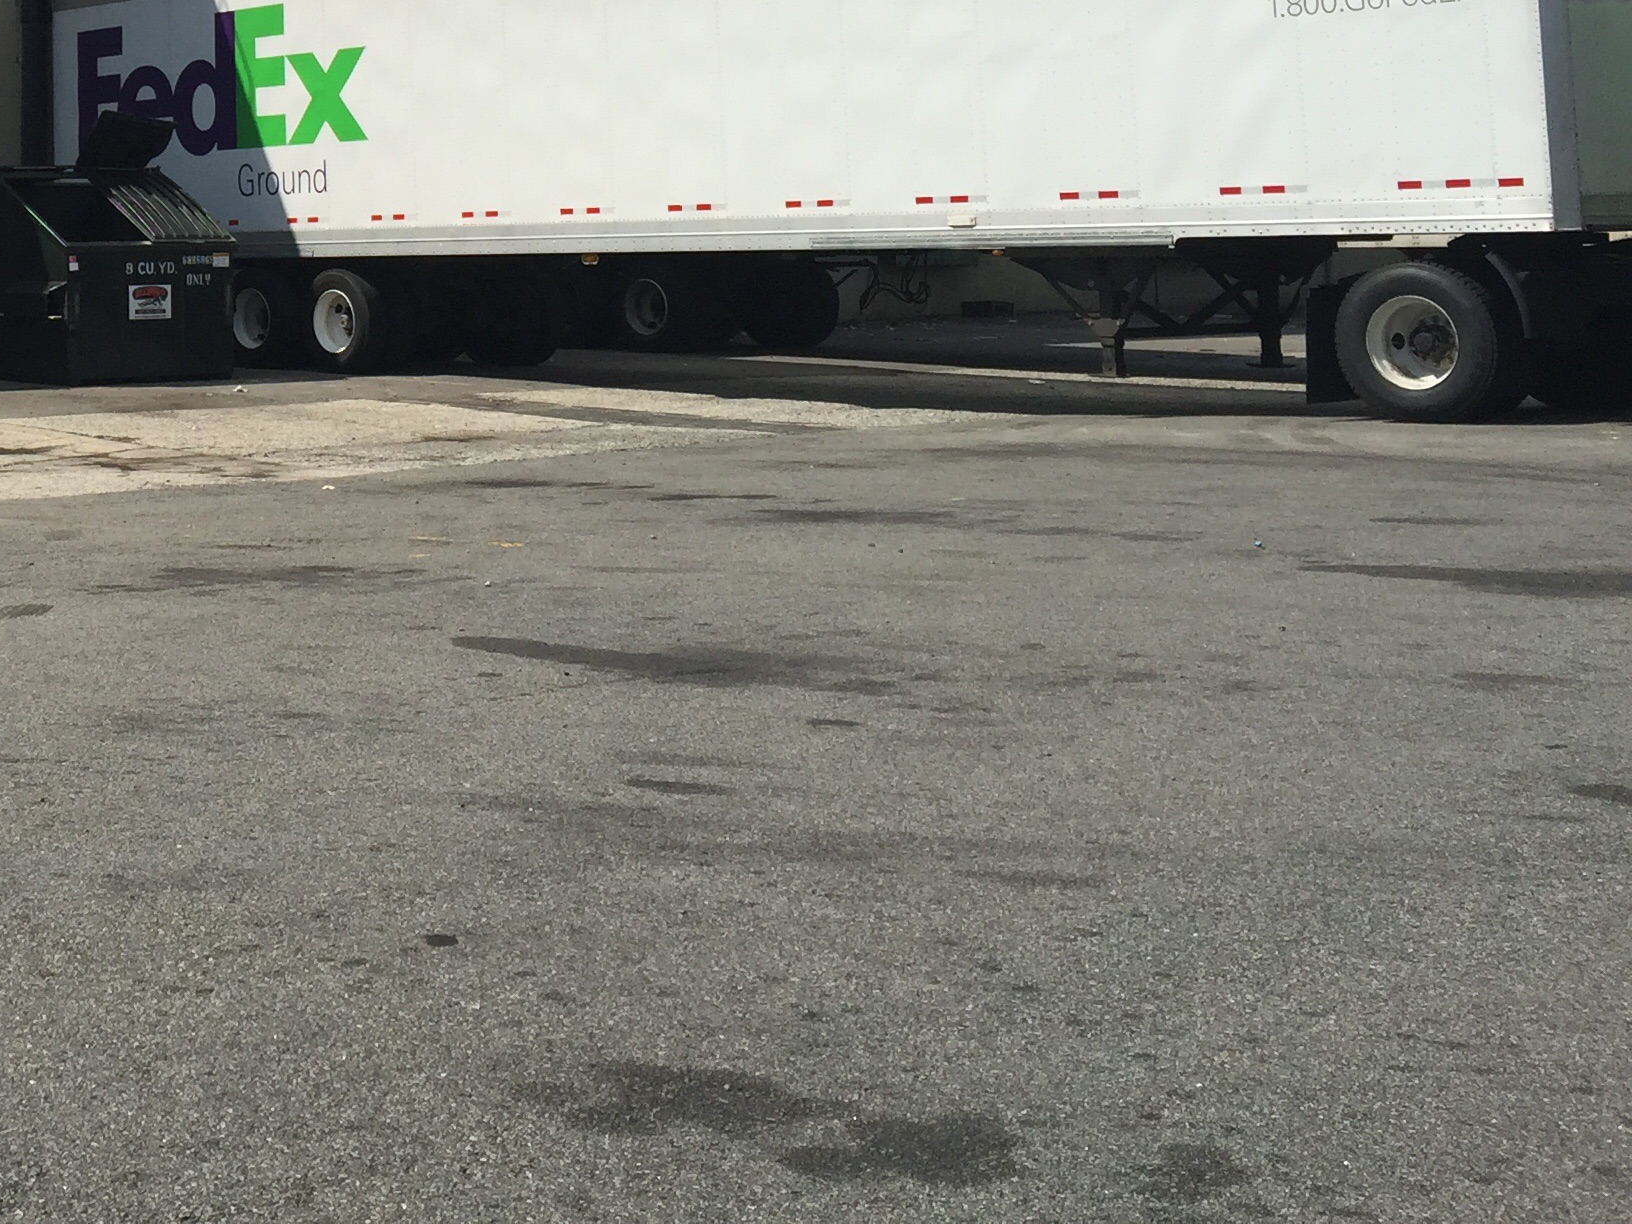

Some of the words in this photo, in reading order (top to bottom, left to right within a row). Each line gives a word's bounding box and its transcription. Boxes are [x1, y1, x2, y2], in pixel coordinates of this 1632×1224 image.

[76, 3, 369, 161] FedEx
[236, 159, 329, 197] Ground
[125, 262, 134, 276] 8
[186, 273, 211, 286] ONLY
